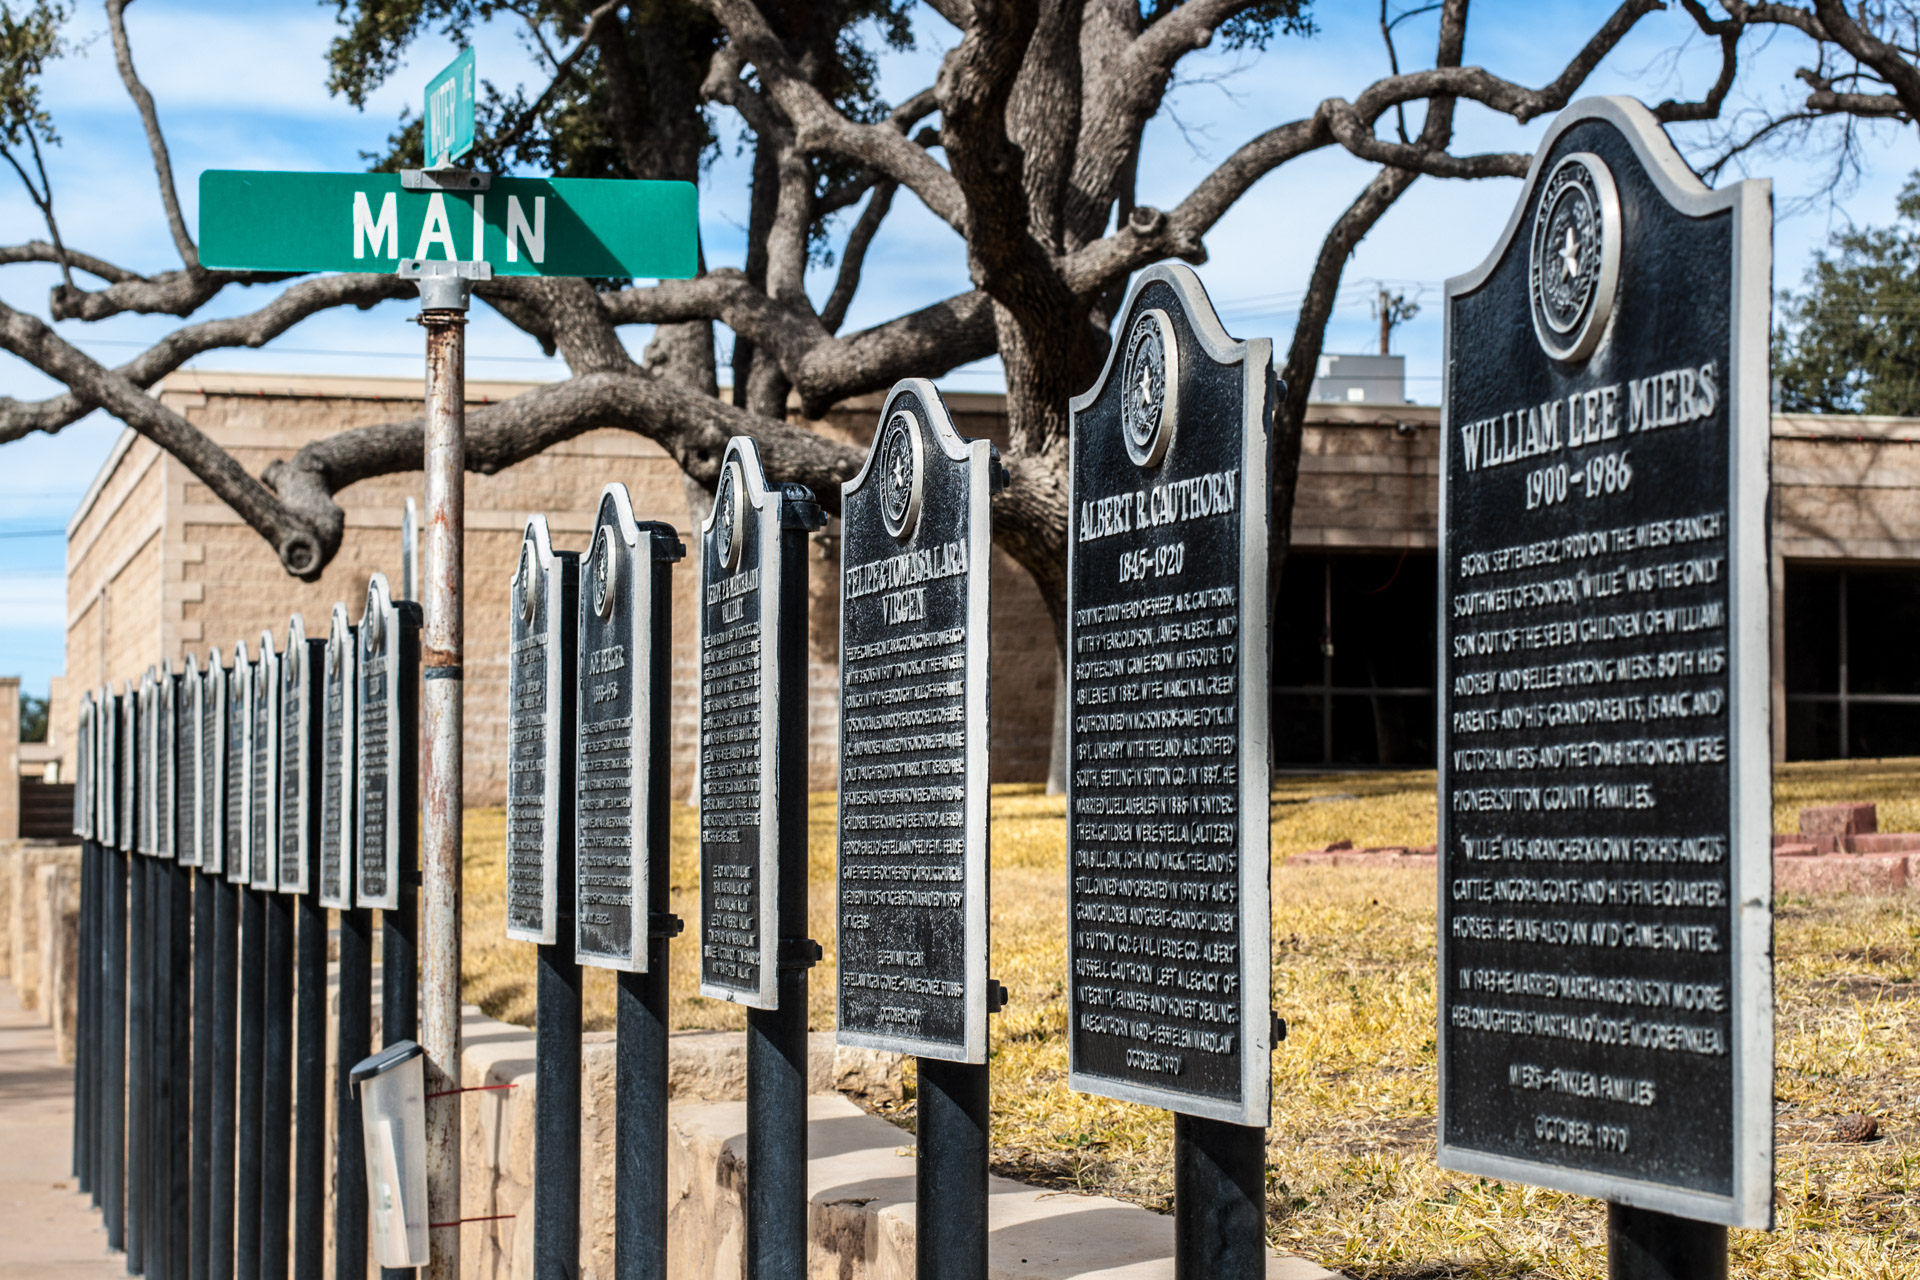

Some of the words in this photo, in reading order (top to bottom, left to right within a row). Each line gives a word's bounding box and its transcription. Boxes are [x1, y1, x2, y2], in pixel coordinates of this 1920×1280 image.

[430, 77, 456, 159] WATER
[462, 62, 473, 102] AVE
[1576, 165, 1592, 183] OF
[353, 190, 546, 264] MAIN
[1461, 398, 1563, 471] WILLIAM
[1568, 385, 1619, 447] LEE
[1628, 361, 1718, 432] MIERS
[1079, 492, 1134, 542] ALBERT
[1136, 490, 1151, 530] R.
[1150, 468, 1237, 527] CAUTHORN
[1461, 553, 1490, 577] BORN
[1493, 541, 1551, 572] SEPTEMBER
[1561, 532, 1589, 558] 1900
[1589, 531, 1607, 555] ON
[1610, 526, 1637, 551] THE
[1636, 520, 1672, 547] MIERS
[1674, 513, 1720, 542] RANCH
[846, 560, 880, 600] FELIPE
[878, 559, 889, 591] &
[886, 548, 934, 589] TOMASA
[932, 537, 968, 579] LARA
[1119, 542, 1184, 583] 1845-1920
[1454, 588, 1513, 617] SOUTHWEST
[1514, 584, 1532, 608] OF
[1627, 567, 1654, 591] WAS
[1657, 563, 1683, 588] THE
[1682, 557, 1722, 585] ONLY
[882, 587, 927, 625] VIRGEN
[1119, 600, 1139, 619] HEAD
[1077, 635, 1095, 653] WITH
[1120, 628, 1138, 649] OLD
[1156, 623, 1182, 643] JAMES
[1217, 615, 1237, 635] AND
[1454, 634, 1475, 657] SON
[1477, 631, 1501, 654] OUT
[1501, 628, 1522, 652] OF
[1520, 625, 1544, 648] THE
[1542, 621, 1577, 646] SEVEN
[1580, 612, 1640, 642] CHILDREN
[1643, 609, 1666, 635] OF
[1664, 602, 1722, 632] WILLIAM
[1076, 661, 1110, 680] BROTHER
[1127, 655, 1150, 674] CAME
[1151, 652, 1173, 671] FROM
[1176, 647, 1219, 668] MISSOURI
[1454, 671, 1497, 696] ANDREW
[1499, 669, 1522, 691] AND
[1657, 651, 1693, 677] BOTH
[1698, 646, 1725, 673] HIS
[1077, 686, 1108, 705] ABILENE
[1141, 680, 1163, 700] WIFE
[1206, 675, 1236, 695] GREEN
[1076, 713, 1109, 733] CAUTHORN
[1110, 713, 1125, 731] DIED
[1146, 710, 1161, 729] SON
[1176, 708, 1201, 727] CAME
[1454, 708, 1498, 732] PARENTS
[1500, 706, 1524, 729] AND
[1524, 703, 1546, 727] HIS
[1648, 692, 1691, 718] ISAAC
[1691, 688, 1723, 714] AND
[1094, 740, 1126, 760] UNHAPPY
[1126, 739, 1147, 757] WITH
[1146, 738, 1162, 757] THE
[1200, 735, 1236, 755] DRIFTED
[1504, 746, 1538, 769] MIERS
[1539, 744, 1566, 768] AND
[1563, 743, 1589, 767] THE
[1685, 736, 1725, 762] WERE
[1144, 766, 1171, 786] SUTTON
[1076, 797, 1106, 814] MARRIED
[1453, 788, 1497, 811] PIONEER
[1496, 787, 1540, 811] SUTTON
[1543, 784, 1590, 810] COUNTY
[1098, 823, 1132, 841] CHILDREN
[1136, 823, 1158, 842] WERE
[1159, 823, 1189, 843] STELLA
[1123, 851, 1142, 869] JOHN
[1145, 852, 1159, 870] AND
[1186, 852, 1204, 871] THE
[1202, 853, 1226, 872] LAND
[1502, 838, 1527, 860] WAS
[1532, 837, 1588, 862] RANCHER
[1586, 837, 1630, 862] KNOWN
[1633, 836, 1659, 862] FOR
[1656, 837, 1682, 862] HIS
[1679, 836, 1724, 863] ANGUS
[1118, 879, 1134, 896] AND
[1133, 879, 1169, 899] OPERATED
[1493, 878, 1542, 901] ANGORA
[1540, 879, 1581, 903] GOATS
[1580, 879, 1607, 904] AND
[1608, 880, 1631, 904] HIS
[1076, 902, 1127, 923] GRANDCHILDREN
[1130, 907, 1144, 925] AND
[1086, 932, 1115, 951] SUTTON
[1203, 941, 1237, 963] ALBERT
[1498, 918, 1515, 941] HE
[1513, 919, 1541, 942] WAS
[1540, 920, 1571, 944] ALSO
[1572, 922, 1587, 943] AN
[1591, 922, 1621, 947] AVID
[1622, 922, 1664, 949] GAME
[1076, 958, 1109, 978] RUSSELL
[1110, 961, 1152, 983] CAUTHORN
[1157, 967, 1177, 986] LEFT
[1185, 970, 1221, 992] LEGACY
[1460, 969, 1471, 988] IN
[1496, 971, 1514, 994] HE
[1559, 976, 1609, 1000] MARTHA
[1116, 990, 1150, 1012] FAIRNESS
[1150, 994, 1169, 1015] AND
[1167, 997, 1199, 1018] HONEST
[1596, 1125, 1629, 1153] 1990
